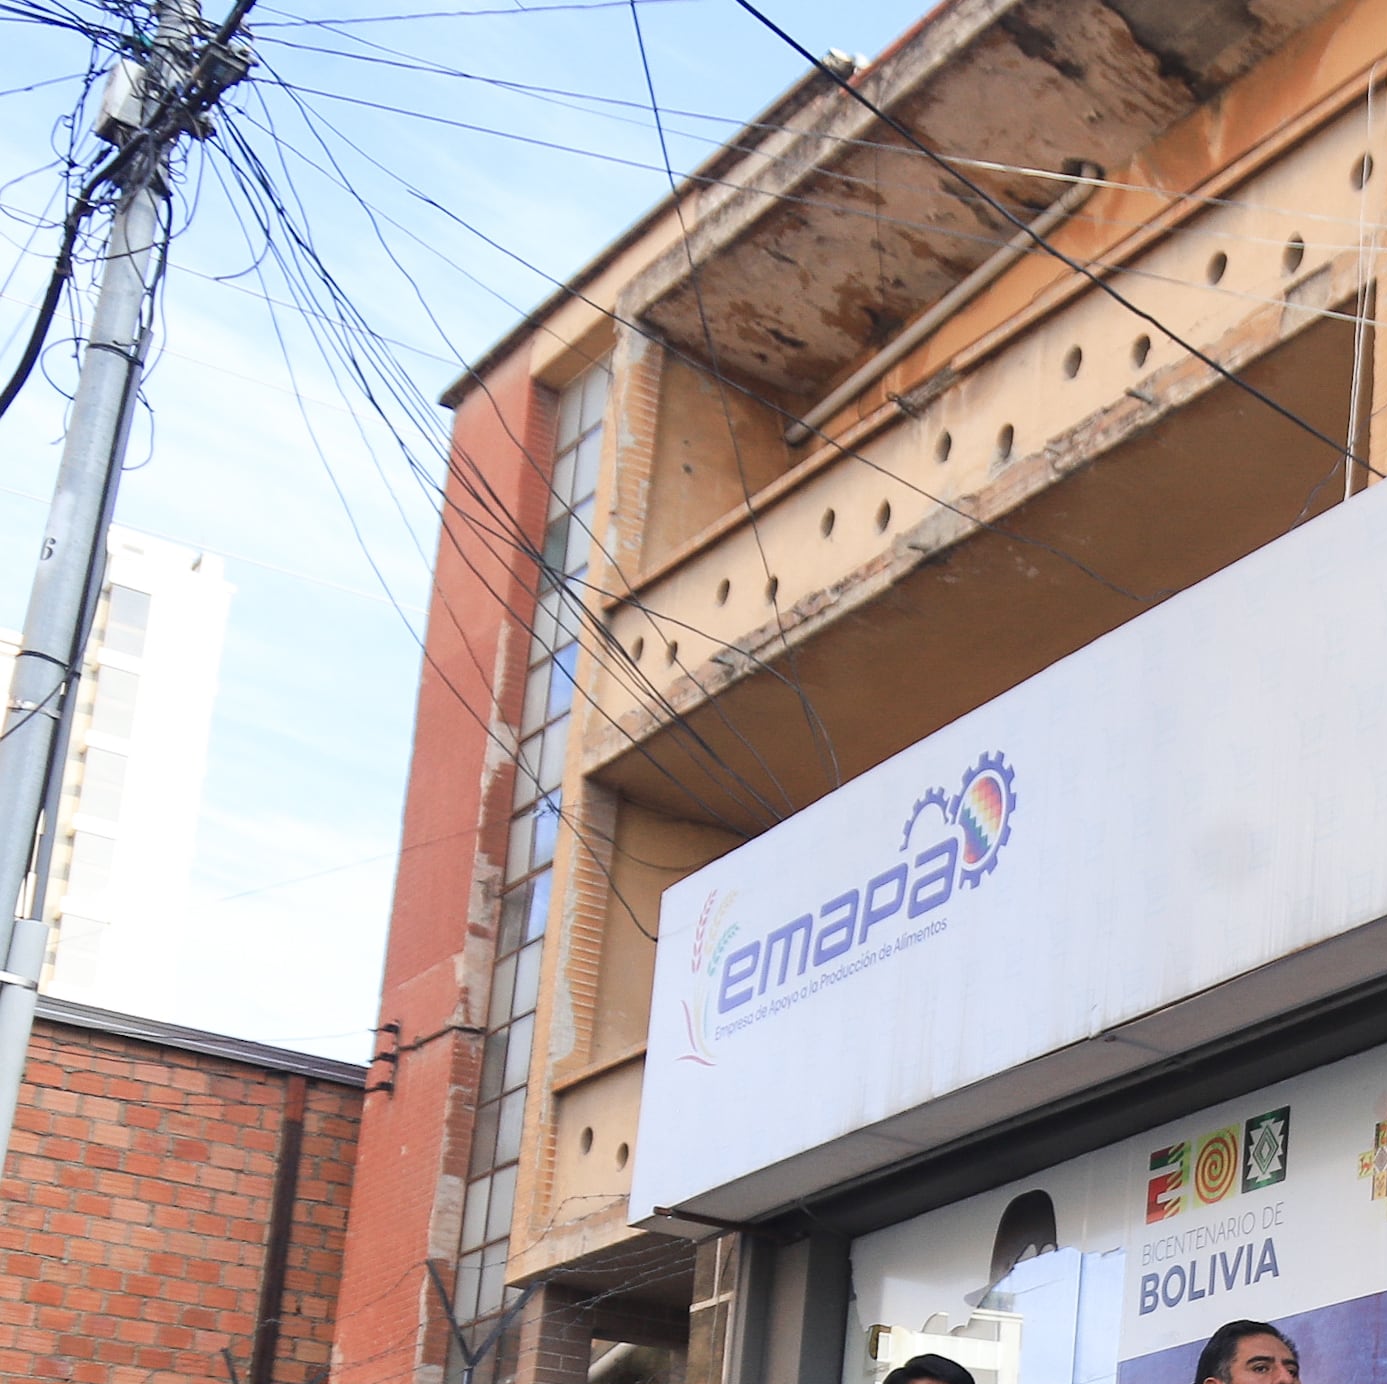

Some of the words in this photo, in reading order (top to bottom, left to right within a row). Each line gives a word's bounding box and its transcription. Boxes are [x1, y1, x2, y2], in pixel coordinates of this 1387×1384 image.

[717, 836, 959, 1015] emapa
[714, 1017, 753, 1041] Empresa
[754, 1004, 768, 1021] de
[768, 991, 799, 1016] Apoyo
[819, 951, 877, 990] Producción
[878, 944, 892, 961] de
[893, 917, 948, 955] Alimentos
[1138, 1237, 1280, 1316] BOLIVIA
[1142, 1212, 1256, 1267] BICENTENARIO
[1262, 1202, 1285, 1230] DE
